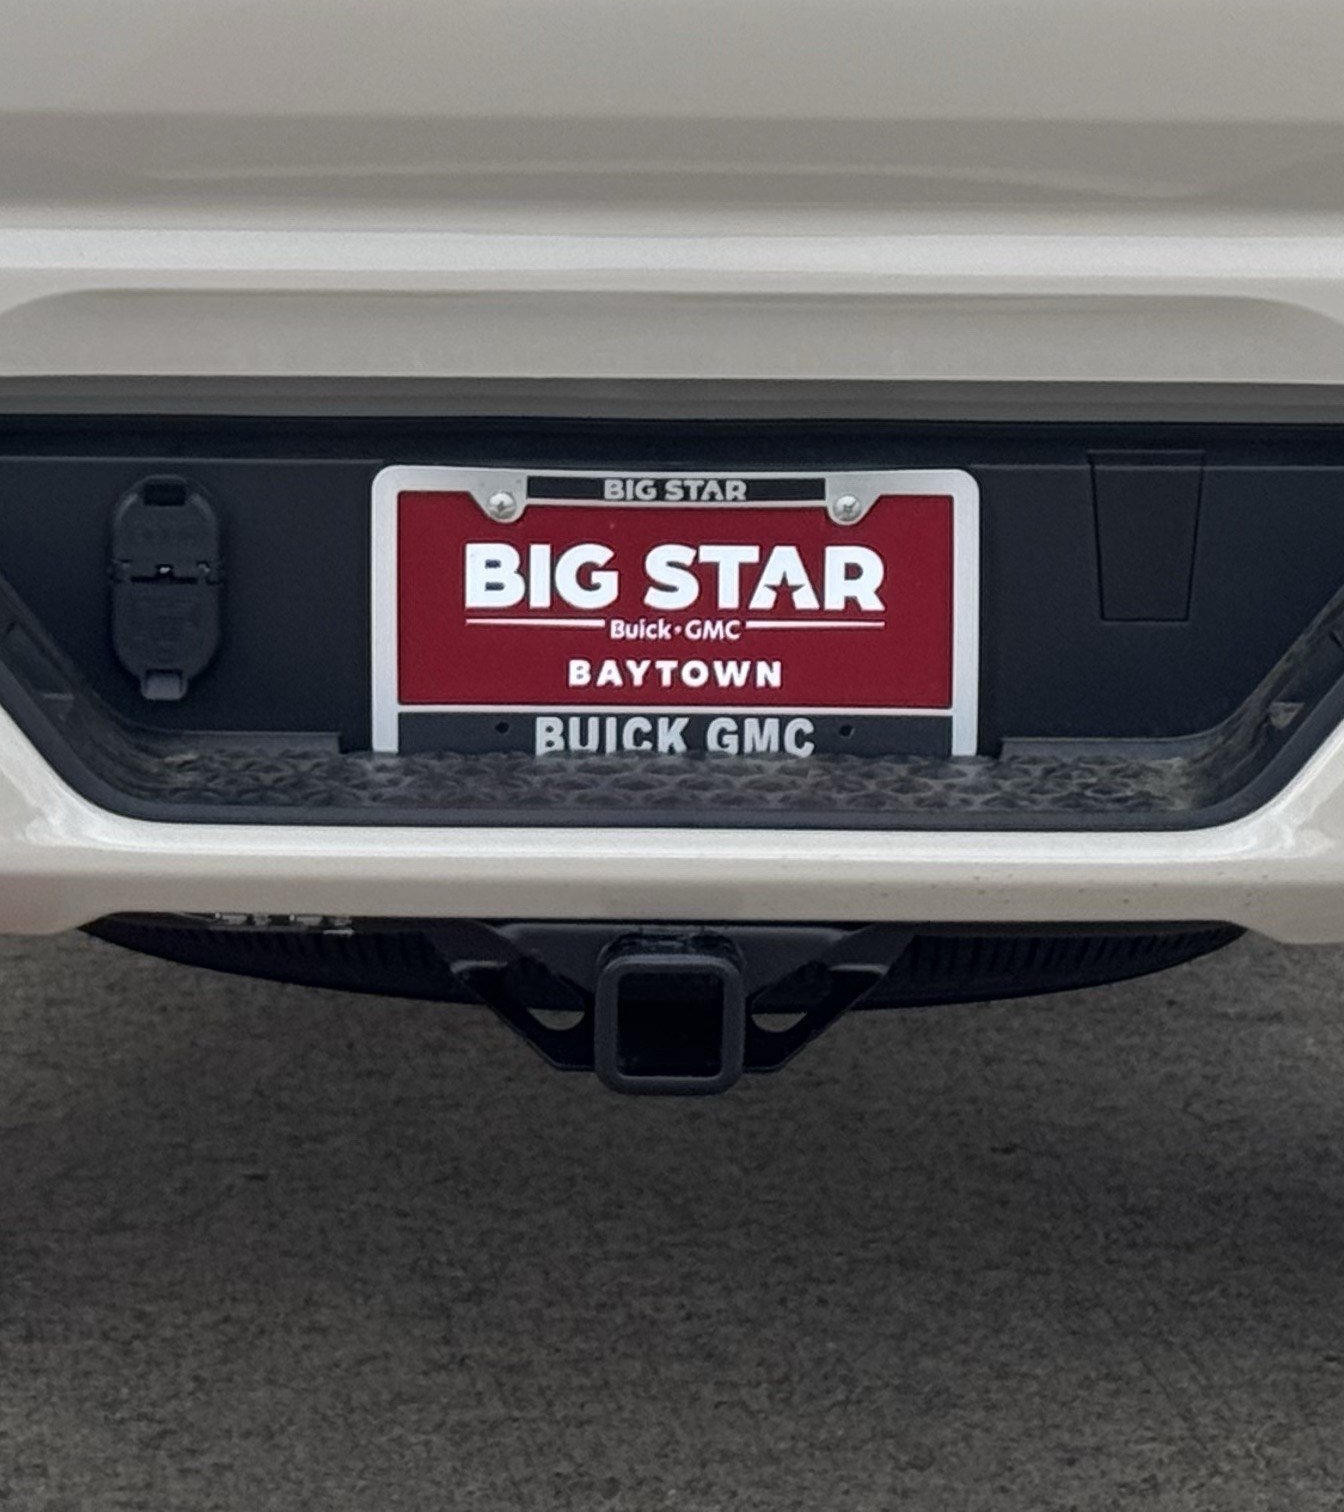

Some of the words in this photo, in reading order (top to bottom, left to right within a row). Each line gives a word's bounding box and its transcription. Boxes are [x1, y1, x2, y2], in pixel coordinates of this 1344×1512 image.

[604, 479, 659, 502] BIG
[665, 479, 748, 502] STAR
[464, 542, 619, 610] BIG
[643, 543, 886, 612] STAR
[568, 659, 783, 688] BAYTOWN
[535, 716, 690, 755] BUICK
[706, 717, 815, 758] GMC
